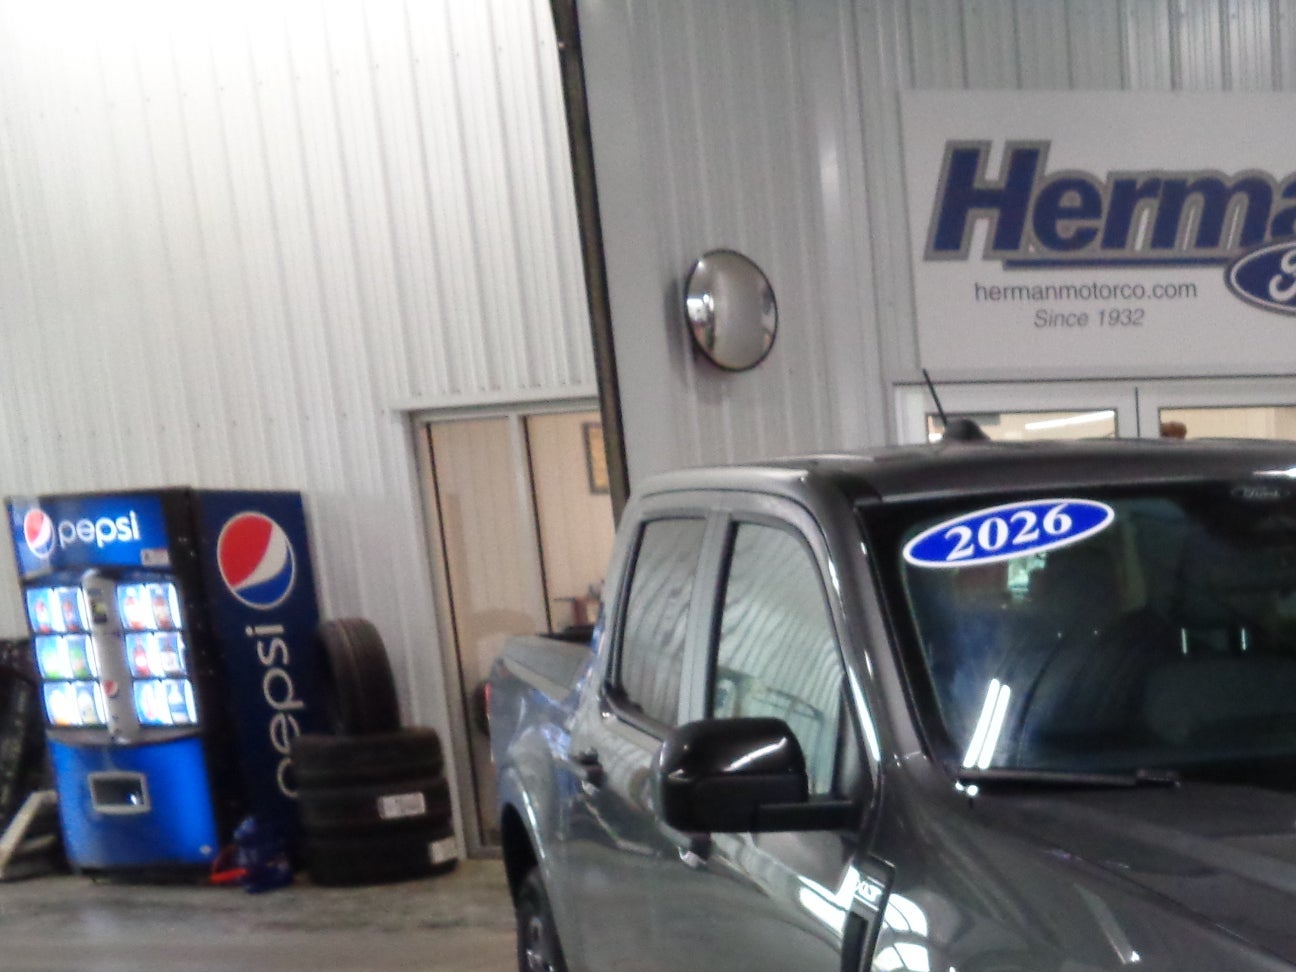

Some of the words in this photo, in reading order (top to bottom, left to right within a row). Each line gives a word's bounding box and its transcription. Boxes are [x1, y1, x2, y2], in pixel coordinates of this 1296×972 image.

[974, 282, 1198, 302] hermanmotorco.com
[1033, 308, 1090, 328] Since
[1098, 308, 1146, 327] 1932
[57, 509, 141, 550] pepsi
[944, 503, 1073, 561] 2026
